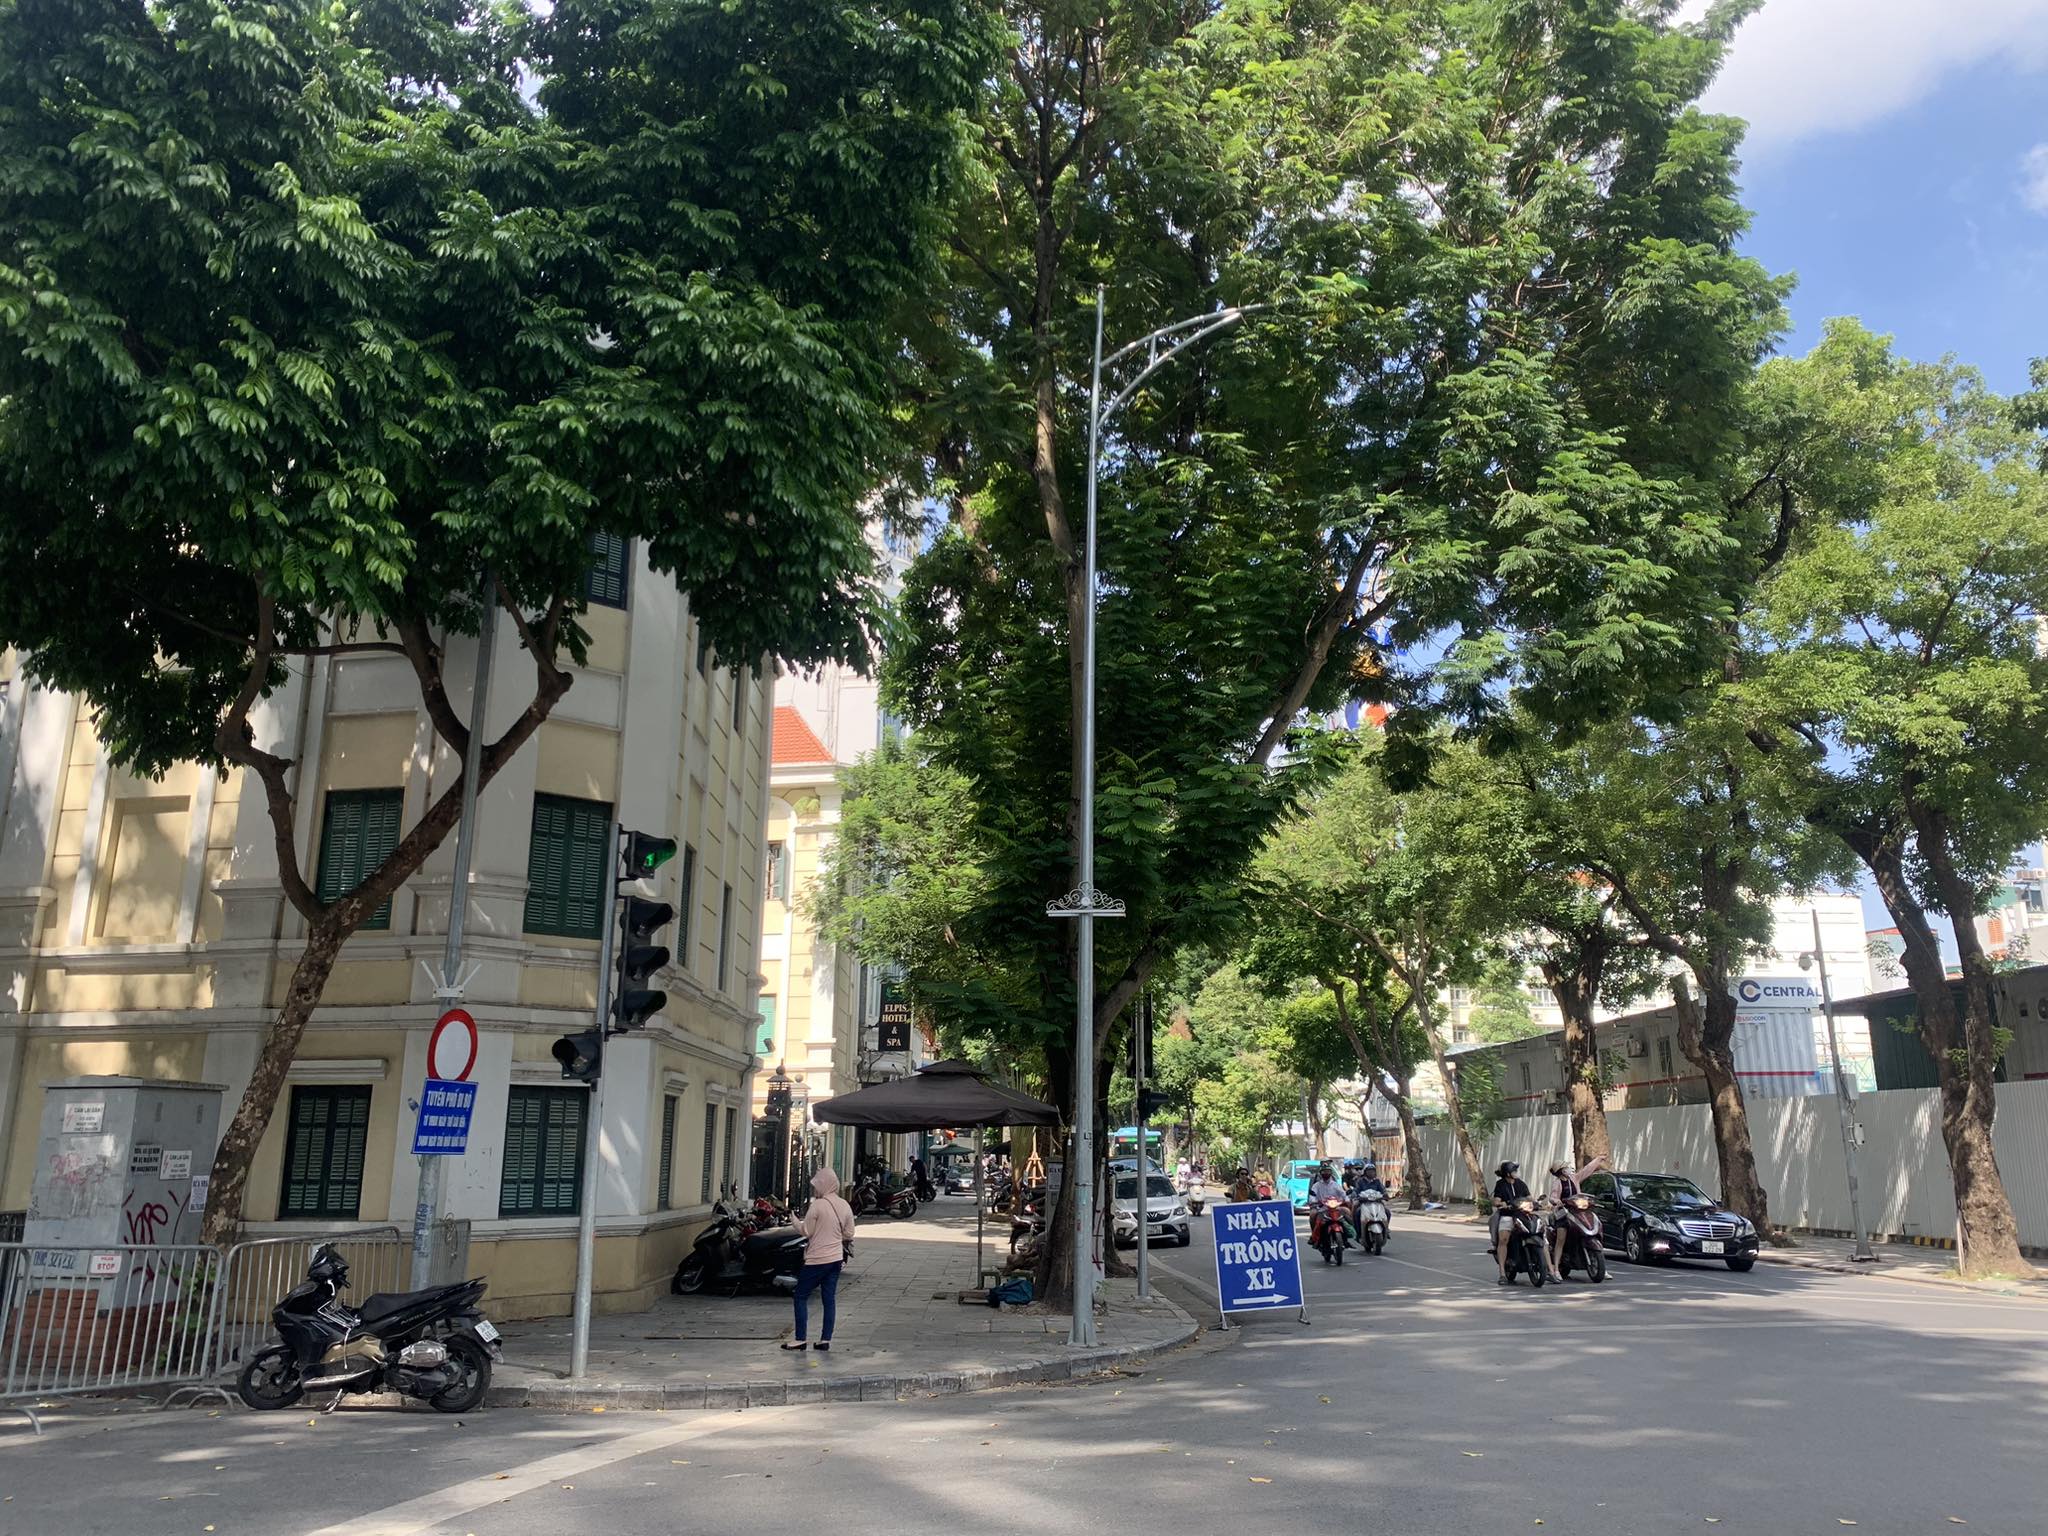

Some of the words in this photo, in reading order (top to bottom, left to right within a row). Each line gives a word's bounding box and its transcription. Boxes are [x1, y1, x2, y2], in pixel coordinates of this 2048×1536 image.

[1763, 987, 1822, 997] CENTRAL
[885, 1003, 907, 1012] ELPIS
[882, 1013, 907, 1023] HOTEL
[892, 1026, 898, 1034] &
[887, 1038, 901, 1047] SPA
[1226, 1207, 1279, 1233] NHẬN
[1220, 1235, 1294, 1265] TRÔNG
[1245, 1267, 1276, 1290] XE
